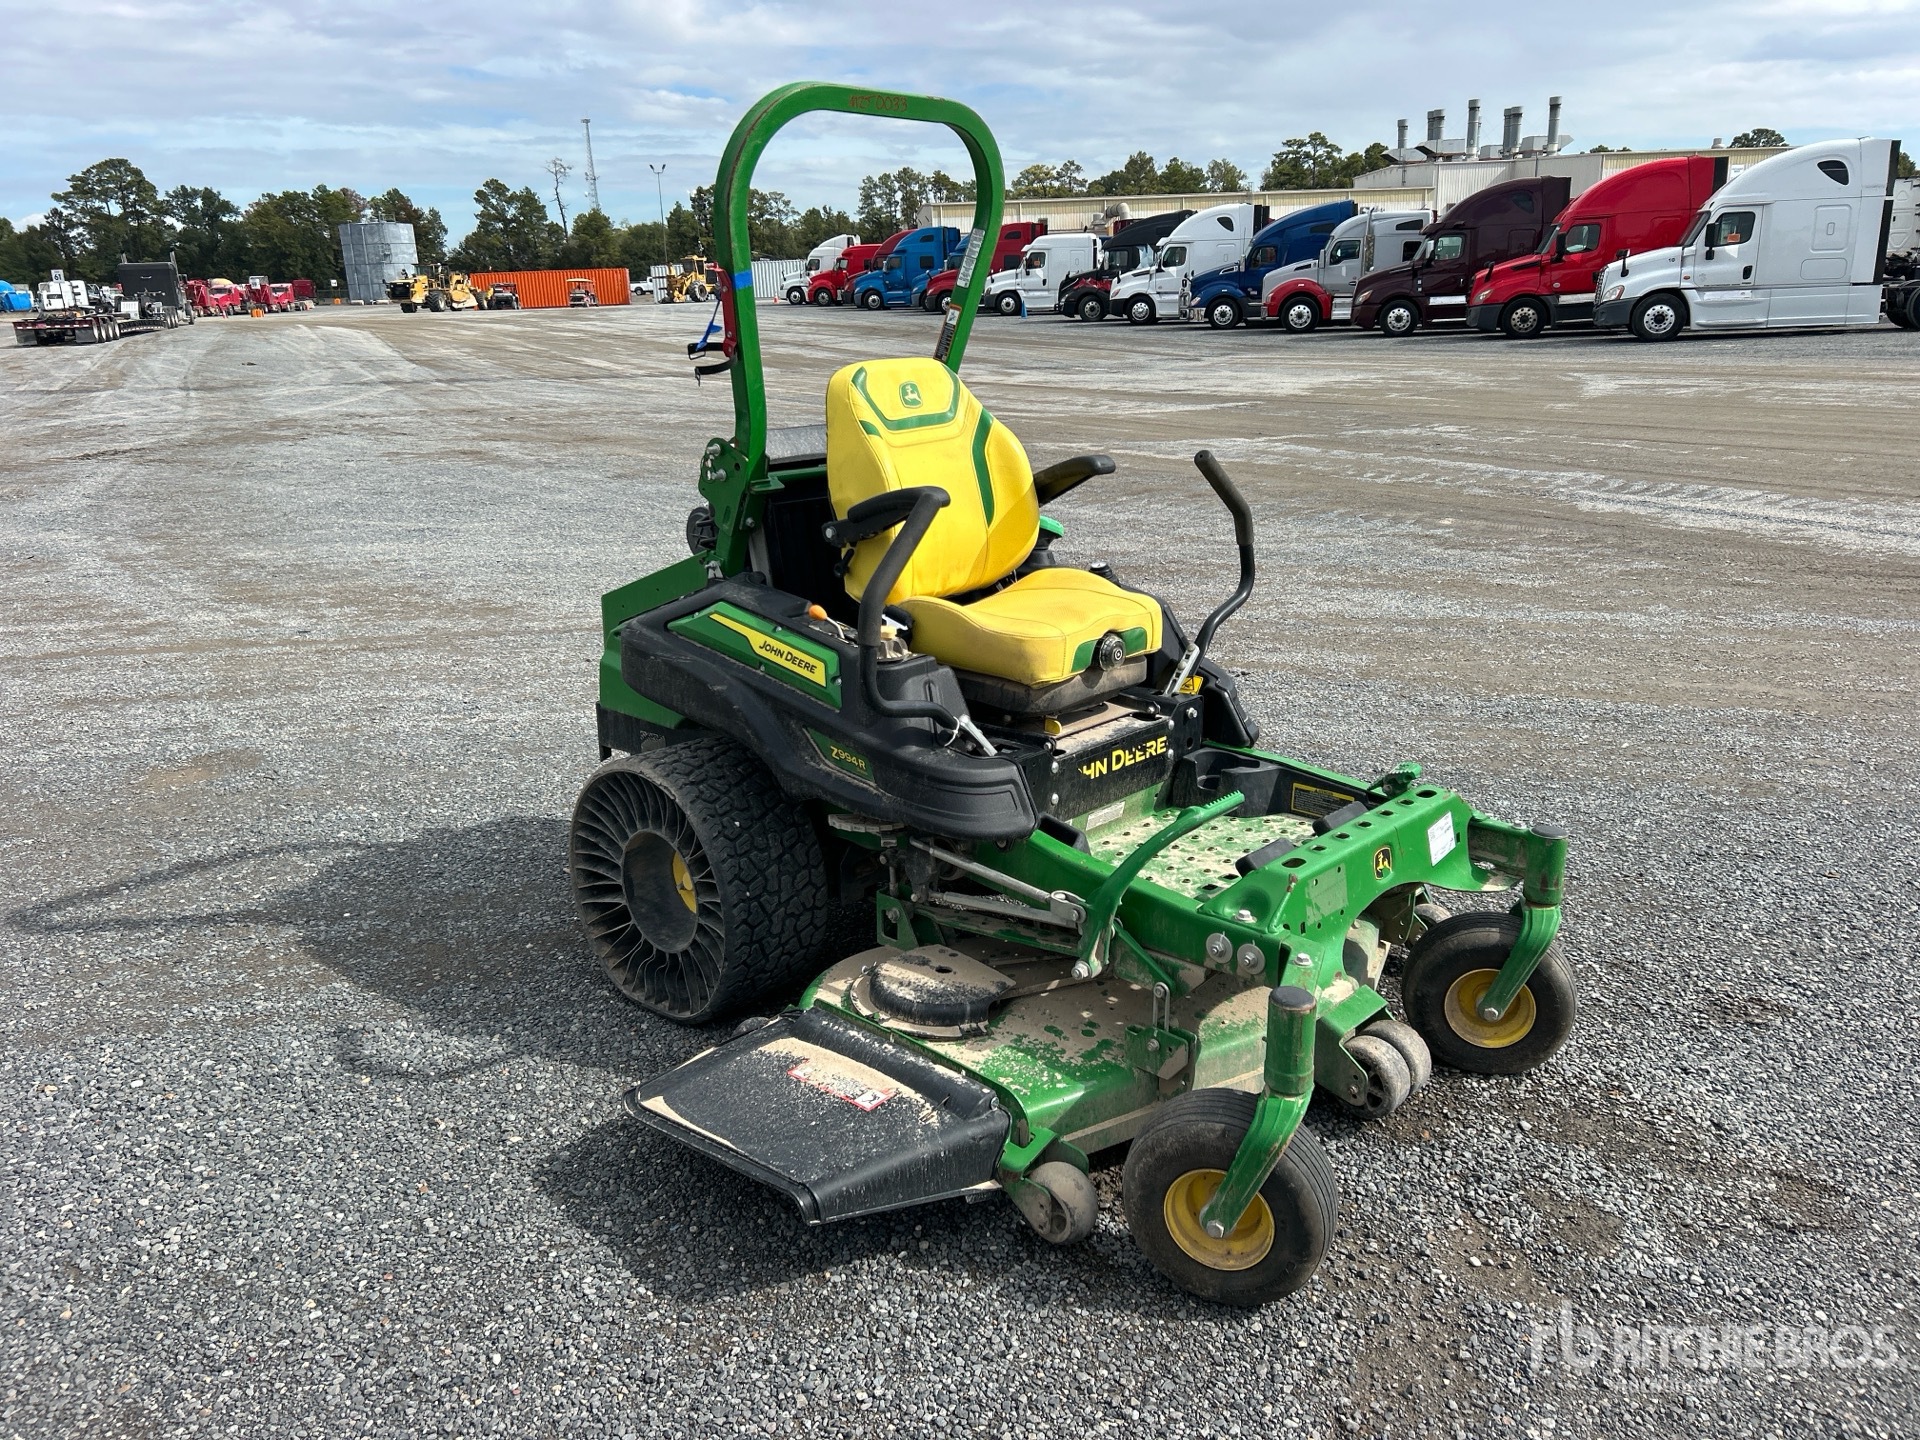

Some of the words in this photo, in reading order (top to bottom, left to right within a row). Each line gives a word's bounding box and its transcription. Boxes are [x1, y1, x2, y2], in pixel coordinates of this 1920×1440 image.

[759, 640, 785, 659] JOHN
[784, 651, 818, 674] DEERE
[830, 745, 866, 770] Z994R
